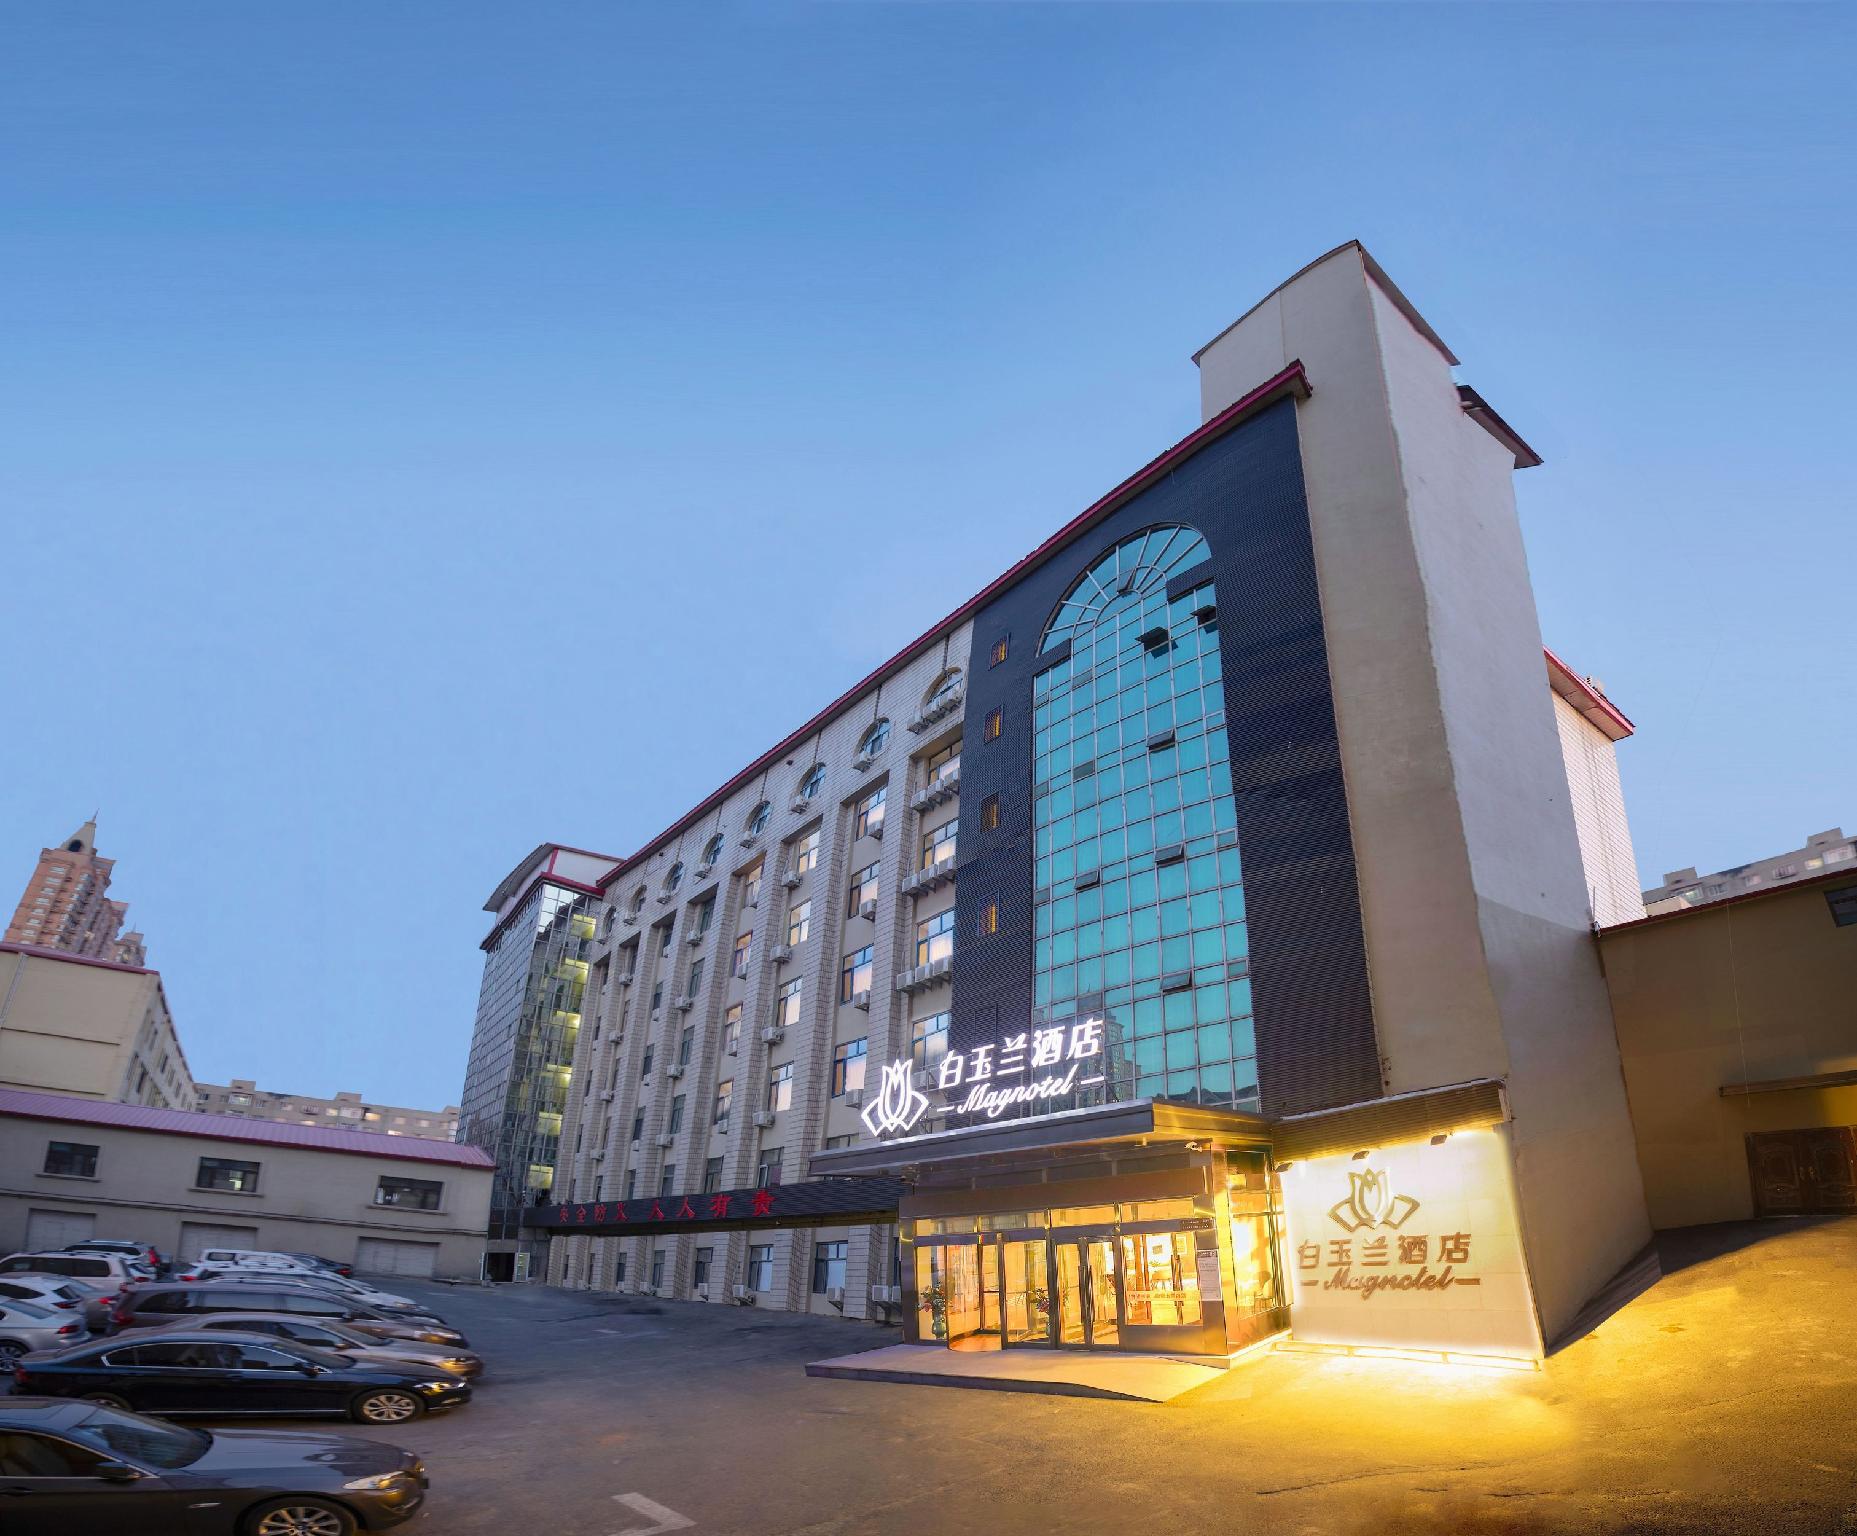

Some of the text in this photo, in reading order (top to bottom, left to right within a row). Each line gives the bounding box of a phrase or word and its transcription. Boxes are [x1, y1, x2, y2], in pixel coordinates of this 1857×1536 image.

[938, 1017, 1104, 1089] 白玉兰酒店
[956, 1063, 1080, 1118] Magnotel
[1297, 1231, 1472, 1270] 白玉兰酒店
[1323, 1265, 1455, 1301] Magnotel
